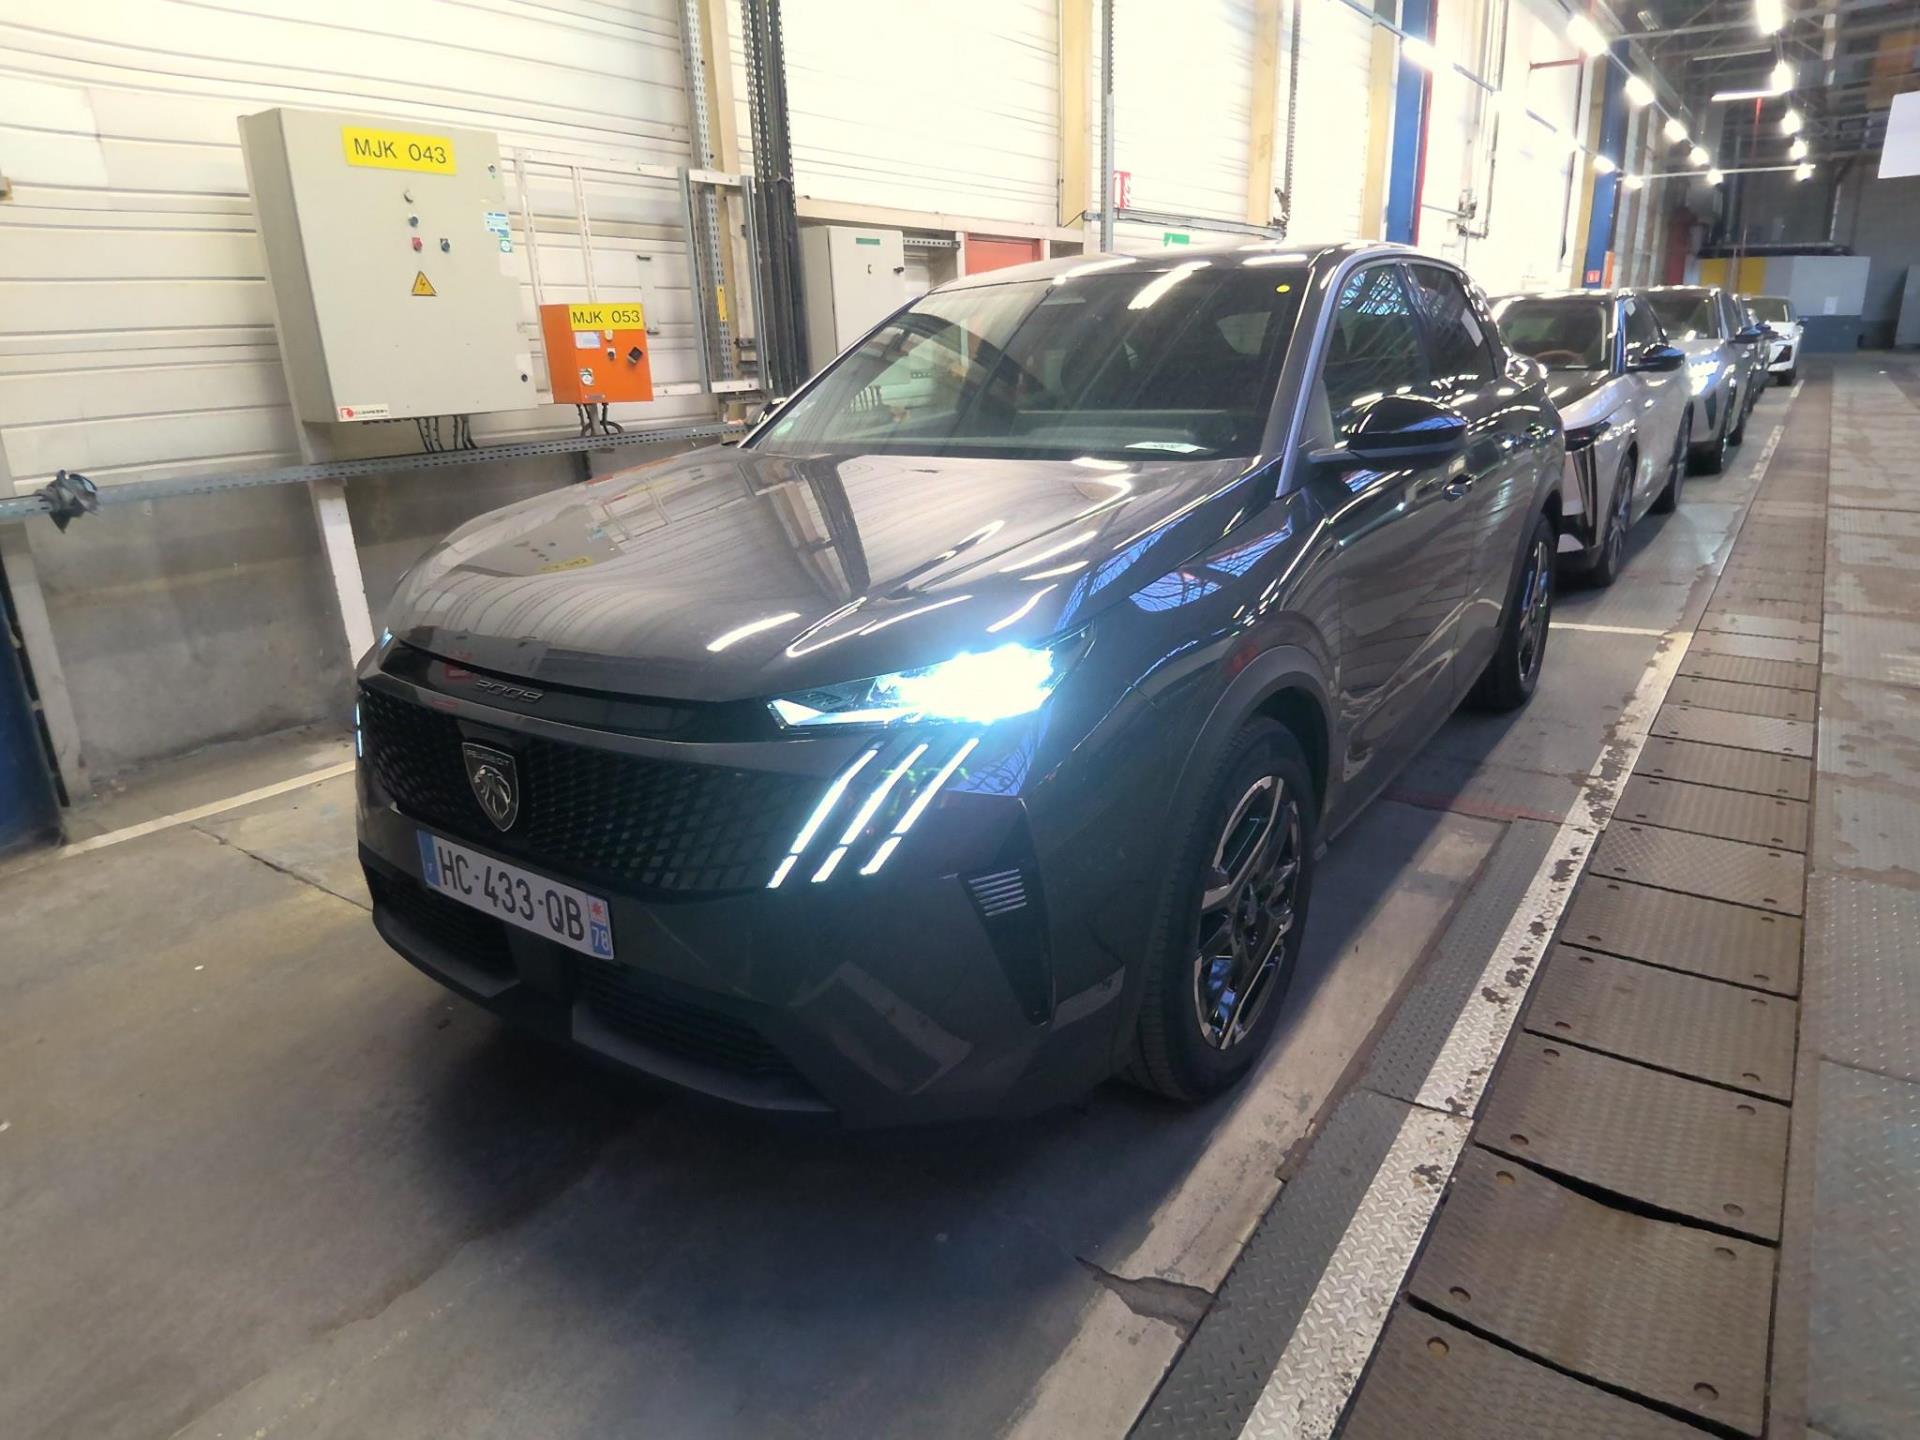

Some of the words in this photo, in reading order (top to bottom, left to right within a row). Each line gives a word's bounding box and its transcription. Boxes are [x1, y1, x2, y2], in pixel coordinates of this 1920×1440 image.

[353, 136, 398, 160] MJK
[407, 142, 448, 165] 043
[572, 310, 604, 325] MJK
[611, 309, 641, 324] 053
[437, 846, 585, 942] HC-433-QB
[591, 925, 609, 952] 78
